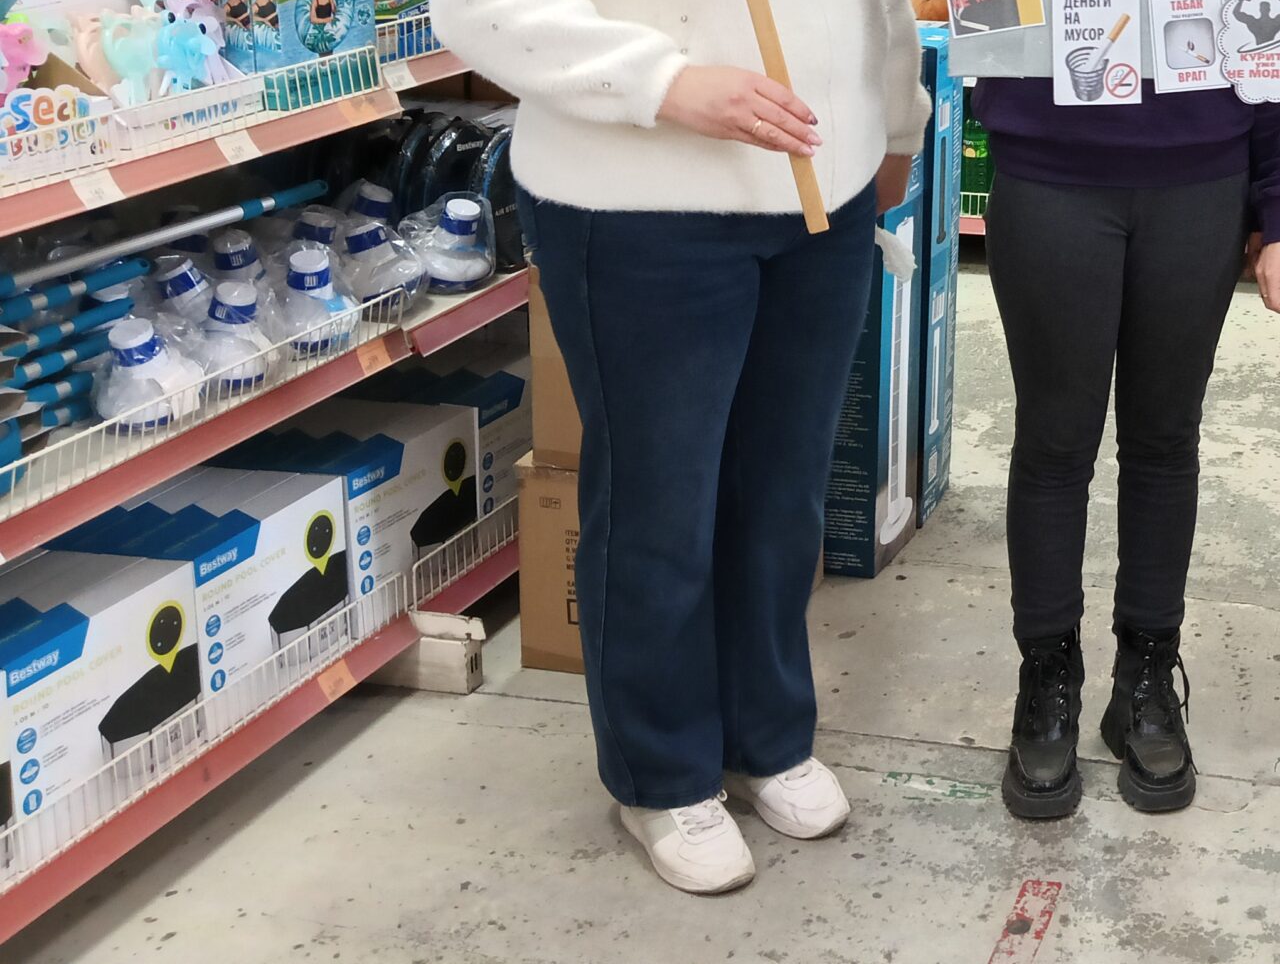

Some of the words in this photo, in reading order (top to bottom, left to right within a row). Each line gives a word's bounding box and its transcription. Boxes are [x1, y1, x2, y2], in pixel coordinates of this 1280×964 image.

[1170, 0, 1204, 12] ТАБАК
[1063, 12, 1081, 25] НА
[1064, 27, 1105, 41] МУСОР
[1177, 70, 1208, 83] ВРАГ!
[1227, 69, 1245, 79] НЕ
[352, 466, 386, 491] Bestway
[200, 547, 239, 578] Bestway
[202, 579, 233, 602] ROUND
[235, 564, 259, 585] POOL
[259, 547, 288, 570] COVER
[9, 650, 60, 686] Bestway
[13, 687, 53, 715] ROUND
[56, 670, 86, 689] POOL
[89, 645, 124, 672] COVER
